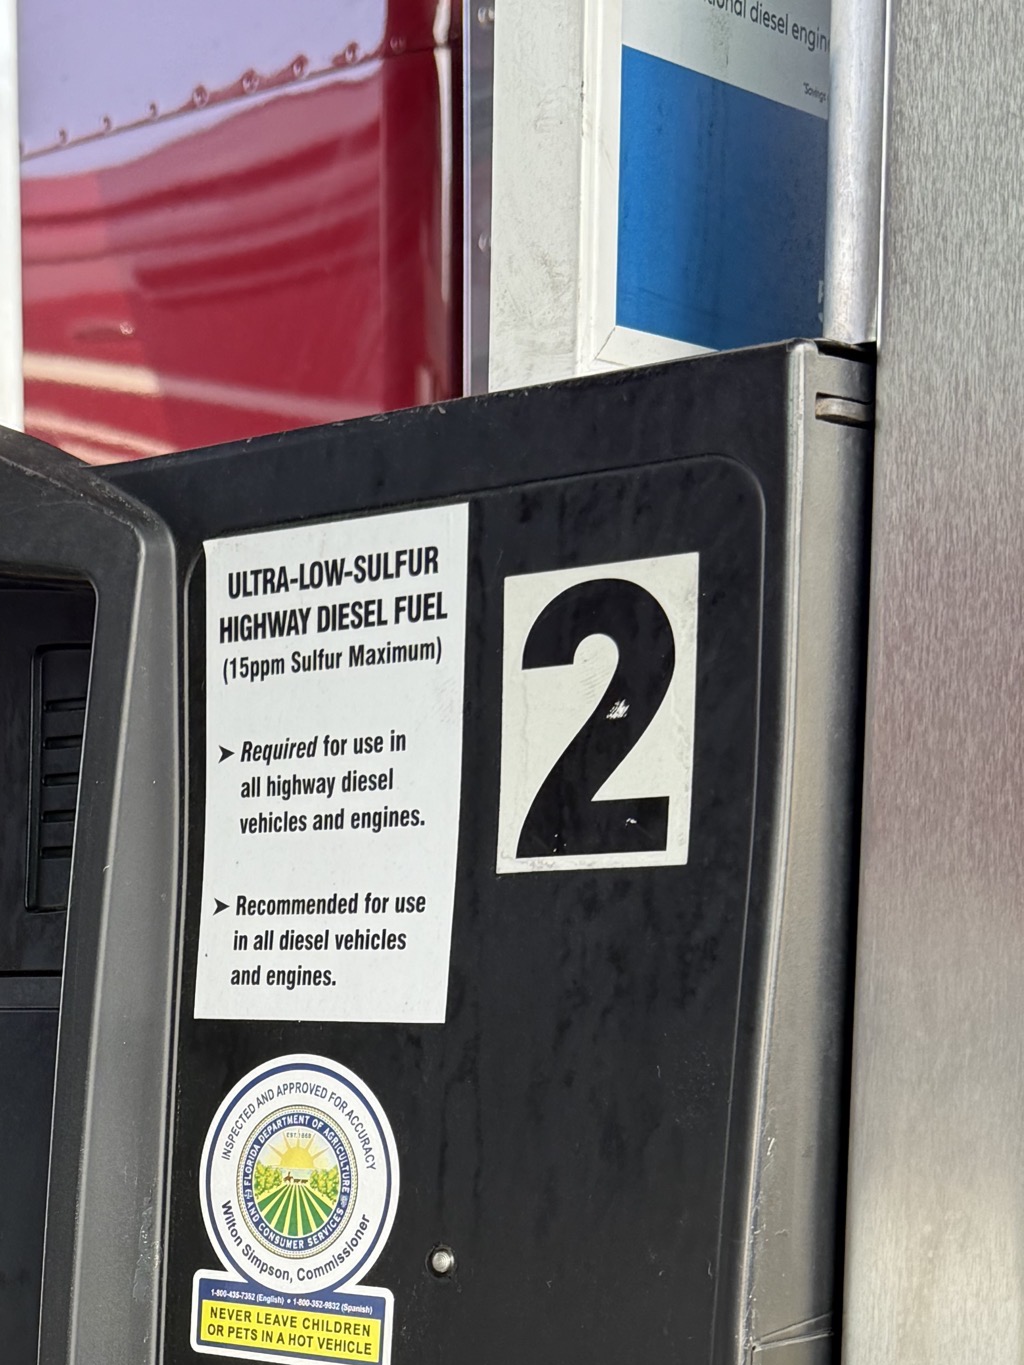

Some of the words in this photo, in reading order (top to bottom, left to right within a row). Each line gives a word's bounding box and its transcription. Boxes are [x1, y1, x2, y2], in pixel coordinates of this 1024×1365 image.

[750, 4, 788, 35] diesel
[792, 22, 830, 52] engin
[228, 546, 439, 599] ULTRA-LOW-SULFUR
[220, 607, 312, 644] HIGHWAY
[317, 599, 388, 633] DIESEL
[394, 592, 448, 624] FUEL
[223, 657, 285, 685] (15ppm
[291, 649, 343, 673] Sulfur
[349, 636, 442, 668] Maximum)
[516, 578, 675, 858] 2
[240, 736, 318, 766] Required
[323, 735, 348, 756] for
[353, 736, 384, 754] use
[390, 729, 407, 751] in
[241, 777, 261, 798] all
[266, 775, 335, 800] highway
[342, 768, 394, 792] diesel
[240, 811, 307, 834] vehicles
[313, 808, 344, 830] and
[351, 806, 425, 833] engines.
[236, 893, 358, 915] Recommended
[365, 892, 389, 913] for
[395, 895, 426, 913] use
[234, 930, 248, 951] in
[254, 930, 274, 950] all
[279, 929, 329, 950] diesel
[335, 929, 407, 950] vehicles
[231, 965, 261, 986] and
[266, 965, 337, 990] engines.
[221, 1103, 256, 1161] INSPECTED
[255, 1089, 274, 1109] AND
[276, 1082, 328, 1099] APPROVED
[328, 1092, 348, 1114] FOR
[345, 1110, 376, 1170] ACCURACY
[244, 1145, 261, 1187] FLORIDA
[258, 1114, 310, 1143] DEPARTMENT
[311, 1120, 325, 1132] OF
[325, 1127, 351, 1194] AGRICULTURE
[221, 1200, 243, 1247] Wilton
[242, 1244, 293, 1283] Simpson,
[297, 1214, 370, 1281] Commissioner
[247, 1201, 260, 1222] AND
[258, 1224, 304, 1249] CONSUMER
[307, 1208, 344, 1247] SERVICES
[210, 1307, 252, 1323] NEVER
[257, 1312, 298, 1328] LEAVE
[302, 1318, 371, 1337] CHILDREN
[256, 1294, 284, 1305] (English)
[341, 1304, 373, 1315] (Spanish)
[208, 1324, 224, 1336] OR
[228, 1326, 258, 1340] PETS
[262, 1330, 273, 1342] IN
[277, 1332, 285, 1344] A
[289, 1333, 313, 1348] HOT
[318, 1336, 372, 1355] VEHICLE
